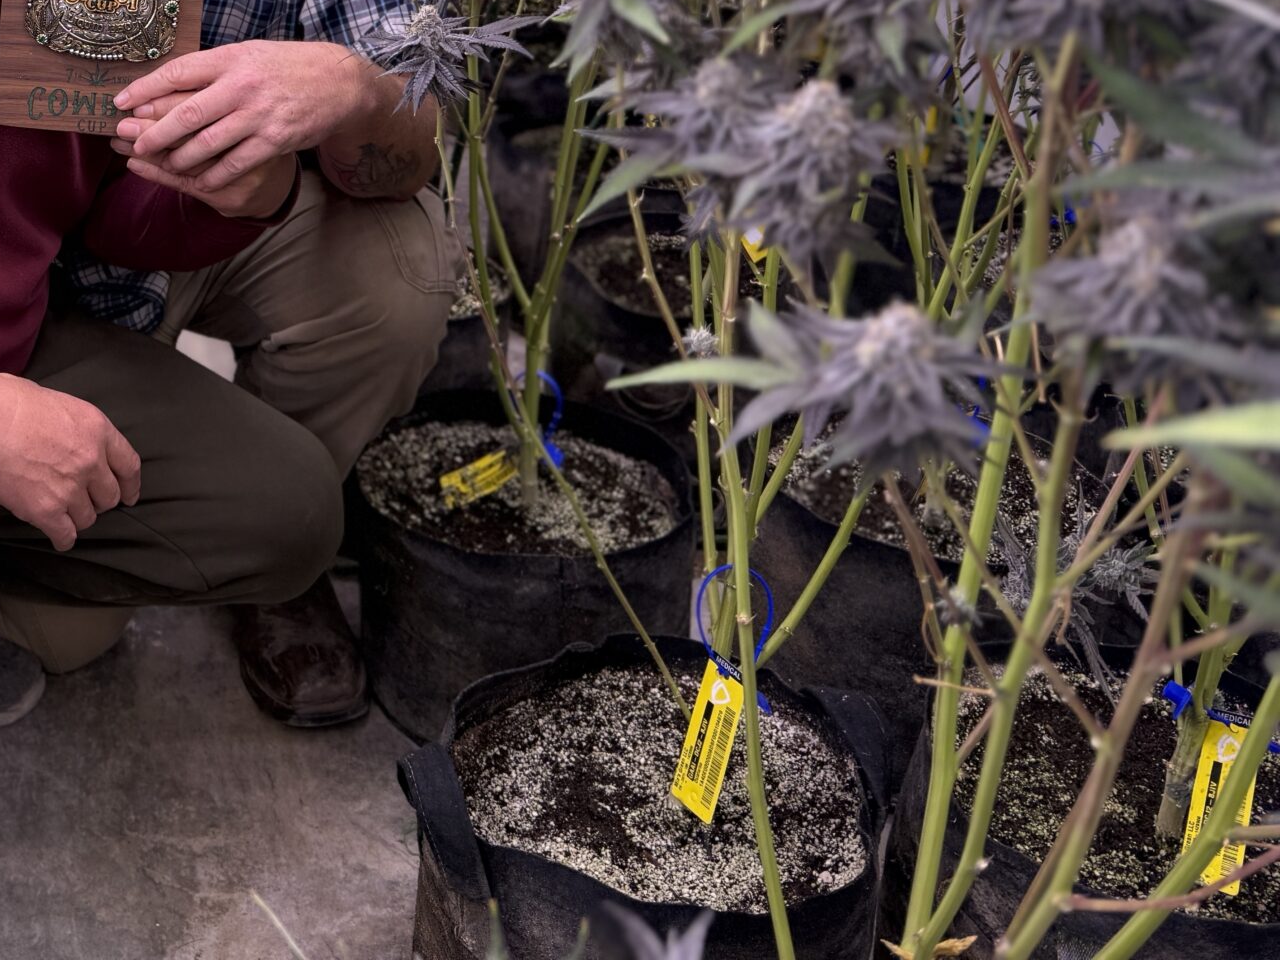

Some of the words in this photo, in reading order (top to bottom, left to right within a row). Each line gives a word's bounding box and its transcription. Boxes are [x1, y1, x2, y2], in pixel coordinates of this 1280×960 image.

[85, 0, 119, 13] CUP
[27, 86, 134, 120] COWB
[77, 119, 107, 132] CUP
[716, 655, 741, 681] MEDICAL
